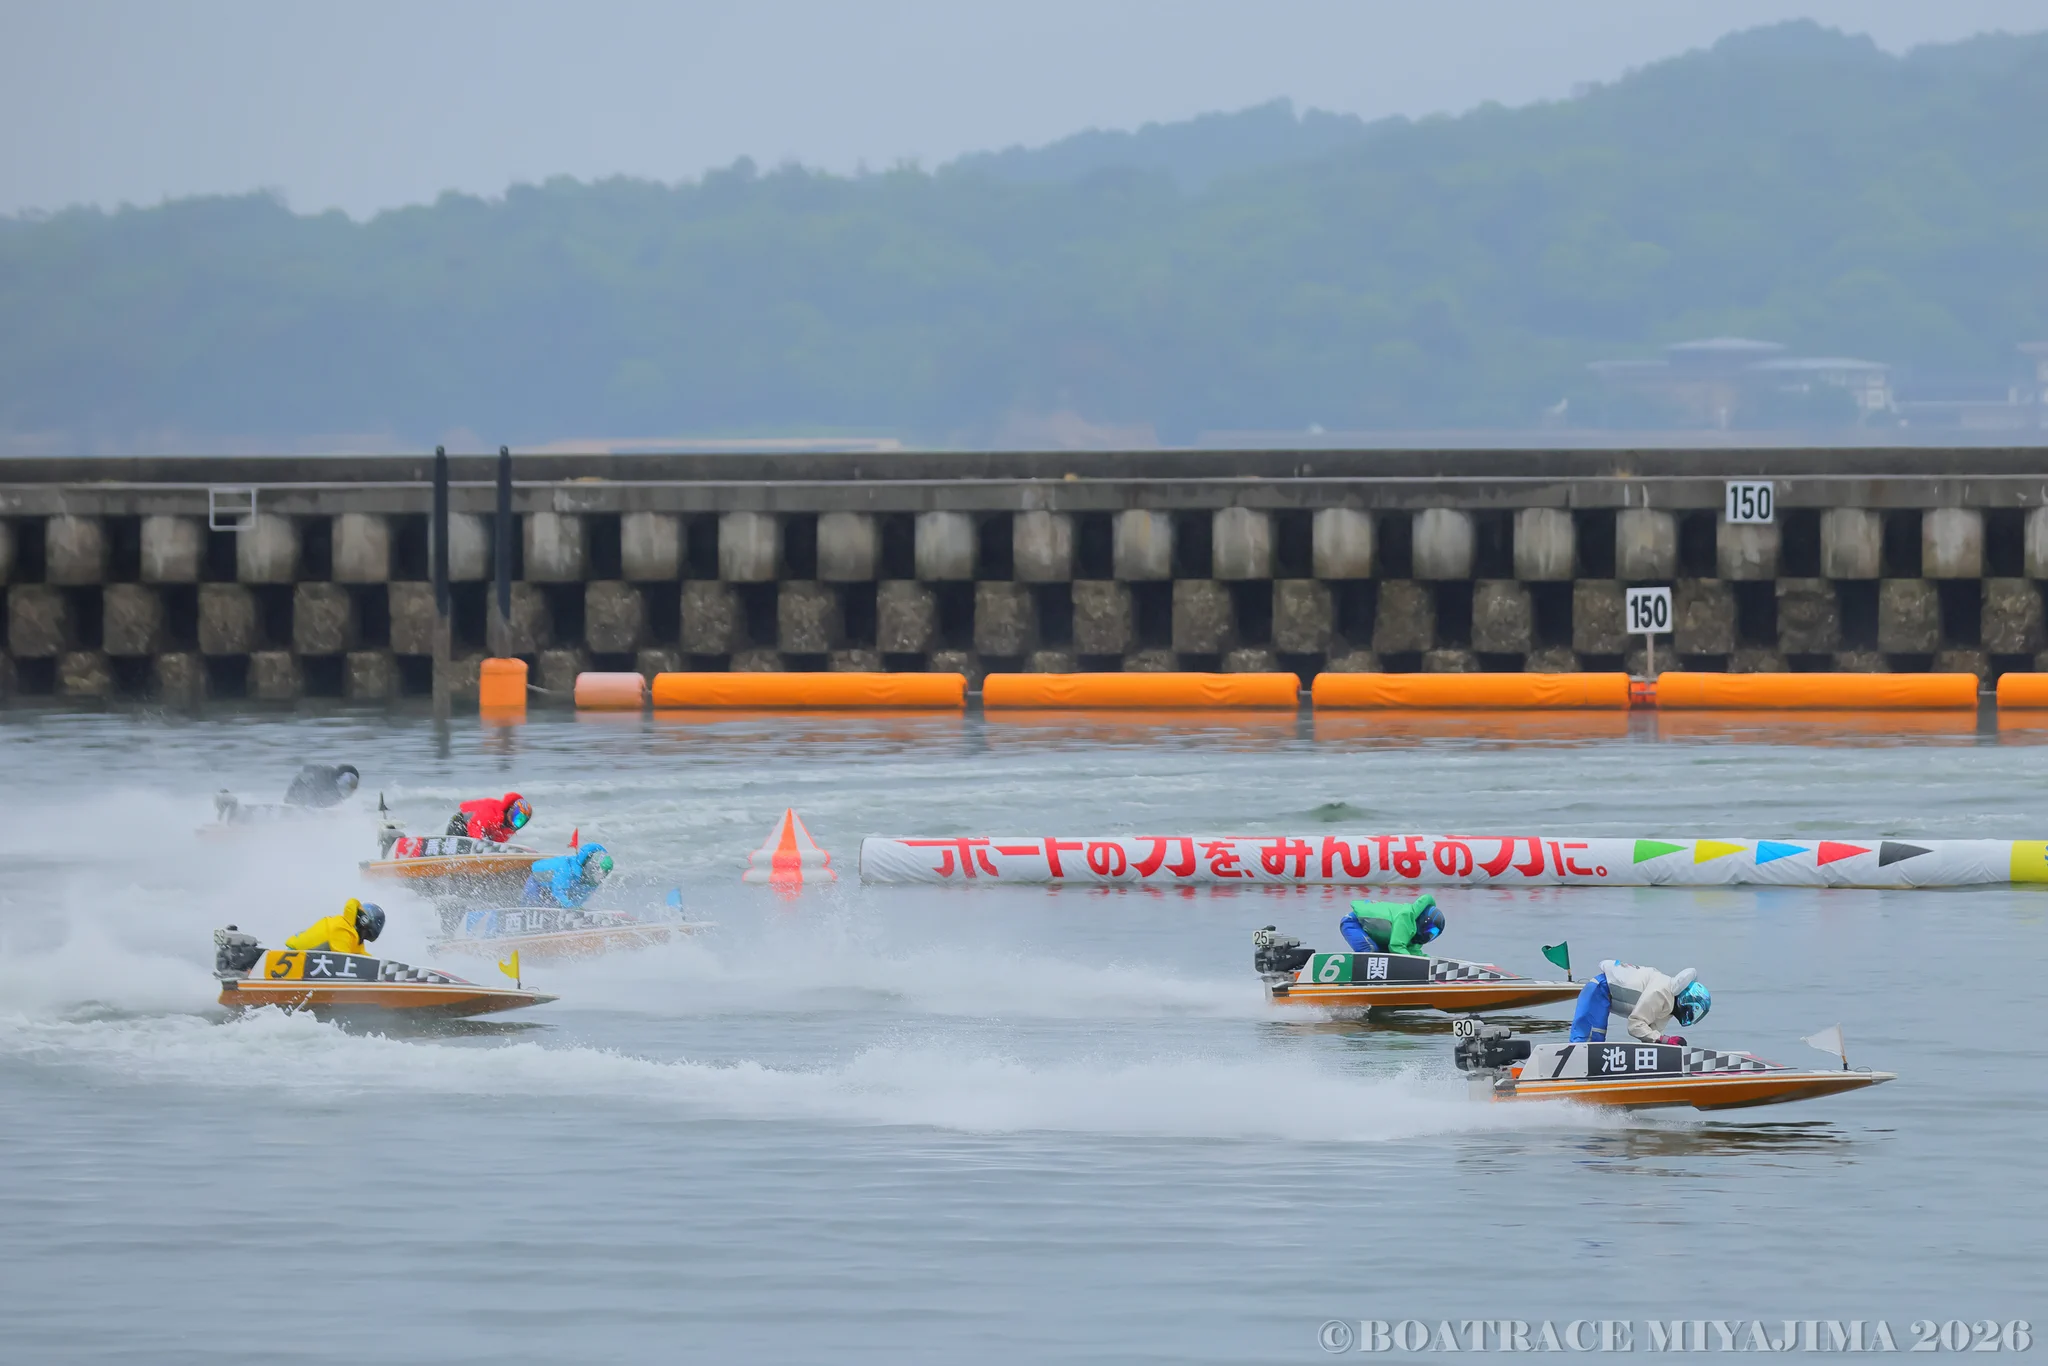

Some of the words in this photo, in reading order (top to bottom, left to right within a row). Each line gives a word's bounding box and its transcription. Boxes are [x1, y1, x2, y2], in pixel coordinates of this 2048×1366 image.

[1730, 486, 1771, 520] 150
[1630, 594, 1668, 629] 150
[505, 910, 543, 932] 西山
[1254, 931, 1268, 945] 25
[271, 952, 299, 978] 5
[310, 954, 358, 978] 大上
[1318, 954, 1346, 982] 6
[1366, 957, 1389, 980] 関
[1455, 1021, 1473, 1037] 30
[1551, 1045, 1576, 1078] 1
[1601, 1046, 1658, 1073] 池田
